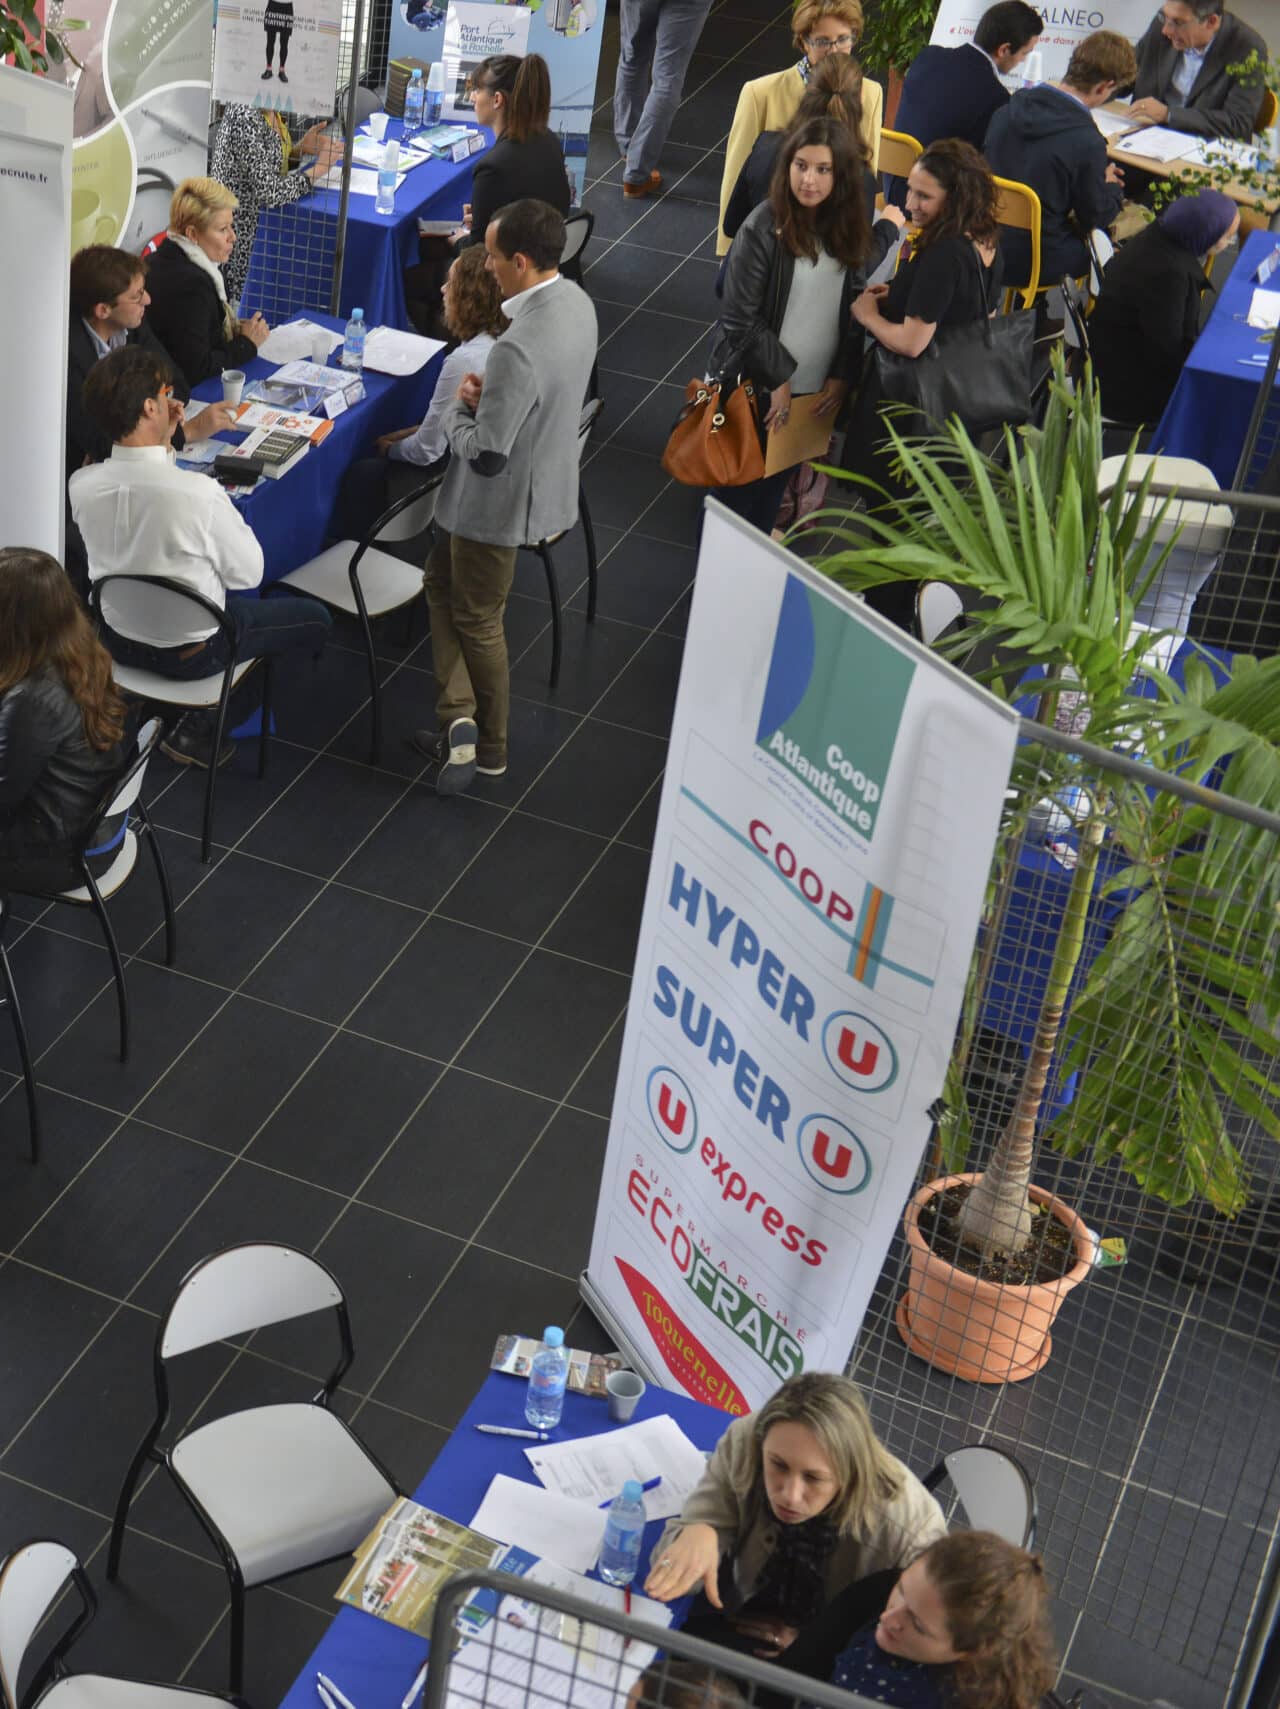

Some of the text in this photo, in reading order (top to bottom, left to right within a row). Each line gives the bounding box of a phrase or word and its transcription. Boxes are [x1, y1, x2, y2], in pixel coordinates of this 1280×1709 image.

[460, 23, 480, 34] Port
[460, 33, 503, 45] Atlantique
[469, 41, 505, 54] Rochelle
[769, 730, 873, 831] Atlantique
[826, 744, 880, 803] Coop
[748, 819, 854, 923] COOP
[668, 861, 880, 1077] HYPER U
[653, 964, 852, 1179] SUPER U
[657, 1082, 828, 1268] U express
